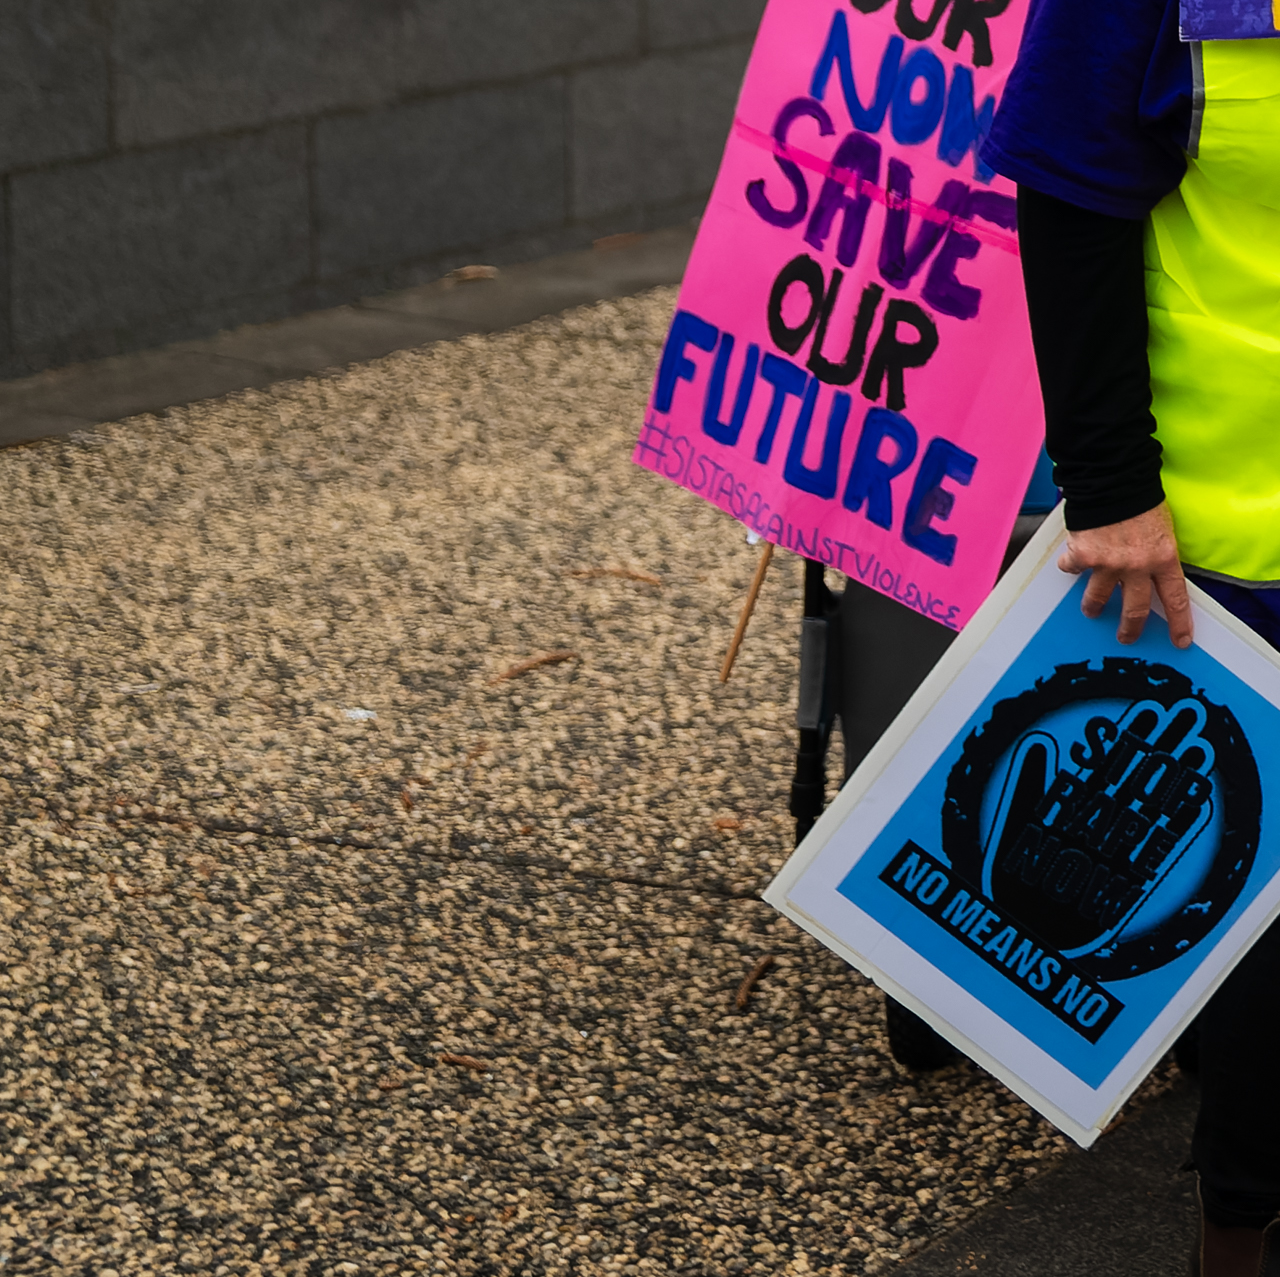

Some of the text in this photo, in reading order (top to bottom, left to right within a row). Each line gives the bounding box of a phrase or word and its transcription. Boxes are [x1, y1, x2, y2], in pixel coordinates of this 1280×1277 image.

[745, 97, 1020, 320] SAVE
[767, 254, 939, 410] OUR
[653, 308, 979, 567] FUTURE
[1034, 768, 1180, 880] RAPE
[1069, 716, 1213, 818] STOP
[893, 852, 1111, 1030] NO MEANS NO
[1002, 822, 1146, 925] NOW
